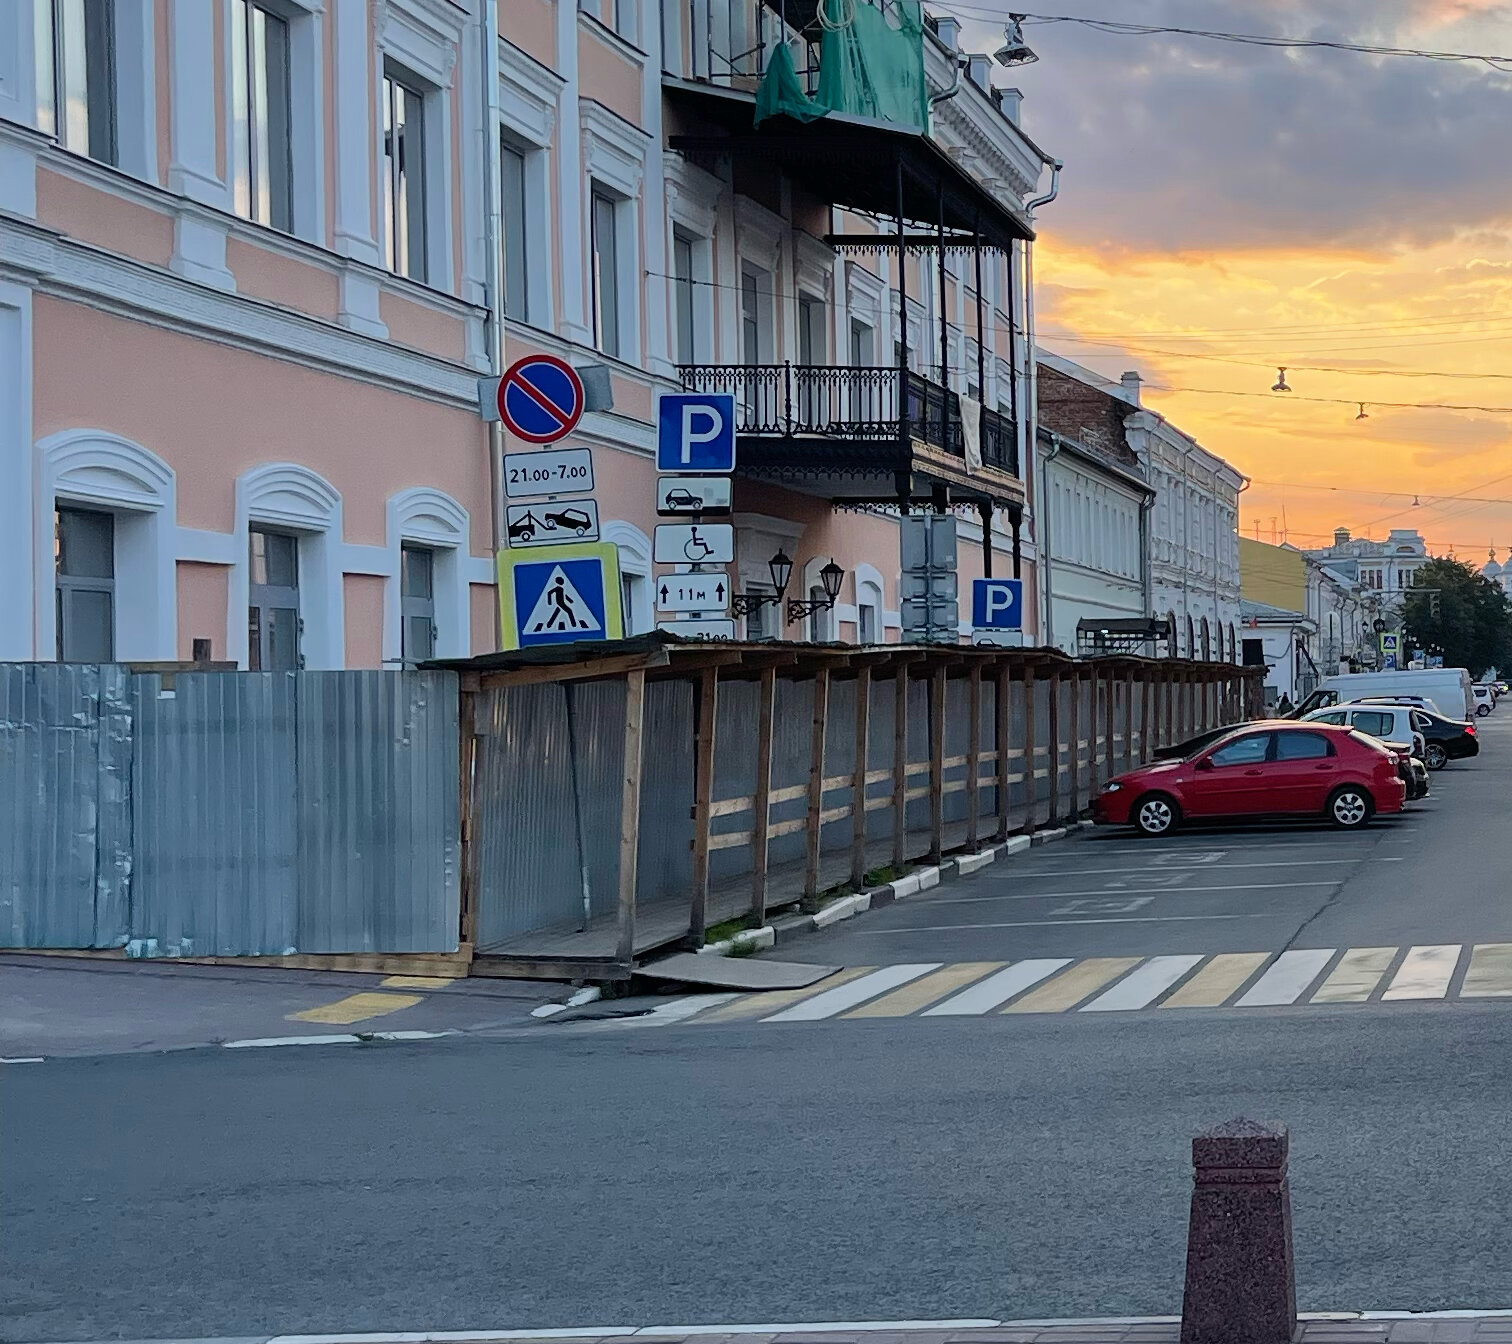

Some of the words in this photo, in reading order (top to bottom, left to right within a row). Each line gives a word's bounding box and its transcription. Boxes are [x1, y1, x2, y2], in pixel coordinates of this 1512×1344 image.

[681, 405, 723, 464] P
[510, 465, 587, 483] 21.00-7.00
[986, 584, 1014, 623] P
